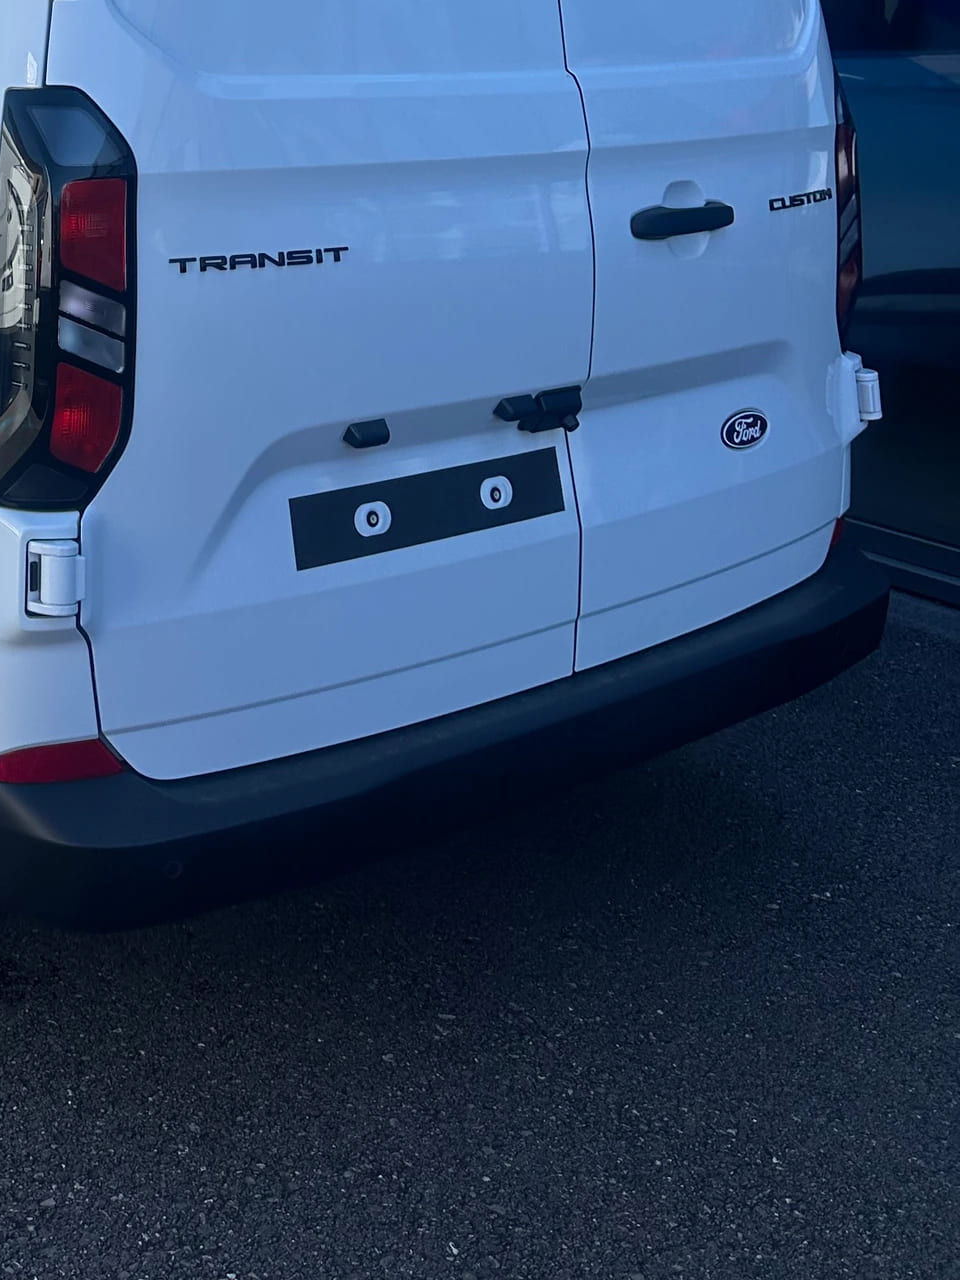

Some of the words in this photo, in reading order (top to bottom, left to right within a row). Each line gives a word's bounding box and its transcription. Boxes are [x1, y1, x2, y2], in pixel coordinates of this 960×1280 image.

[768, 187, 833, 212] CUSTOM
[168, 246, 349, 273] TRANSIT
[733, 417, 761, 443] Ford
